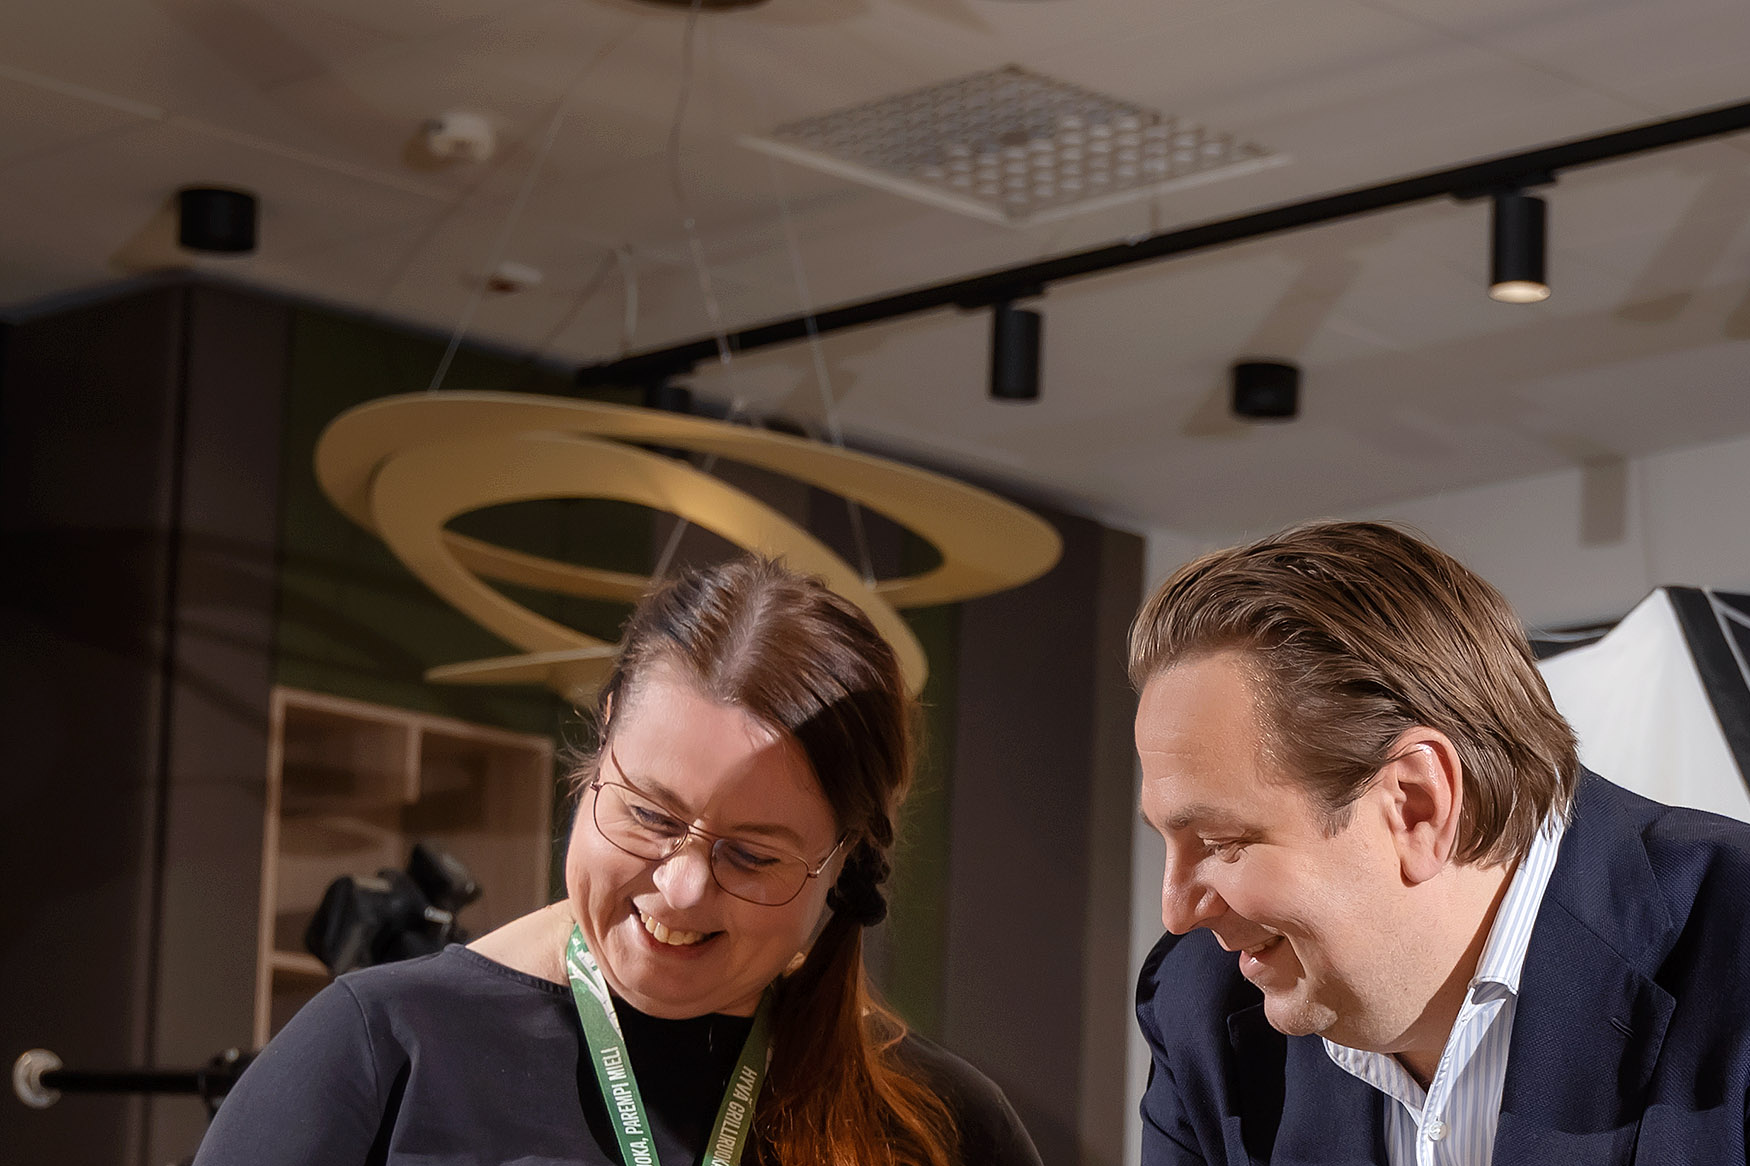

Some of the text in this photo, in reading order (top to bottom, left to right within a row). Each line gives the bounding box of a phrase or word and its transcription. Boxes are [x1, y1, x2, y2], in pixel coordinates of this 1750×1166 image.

[600, 1046, 627, 1081] MIELI
[611, 1082, 644, 1134] PAREMPI
[733, 1065, 757, 1108] HYVÄ
